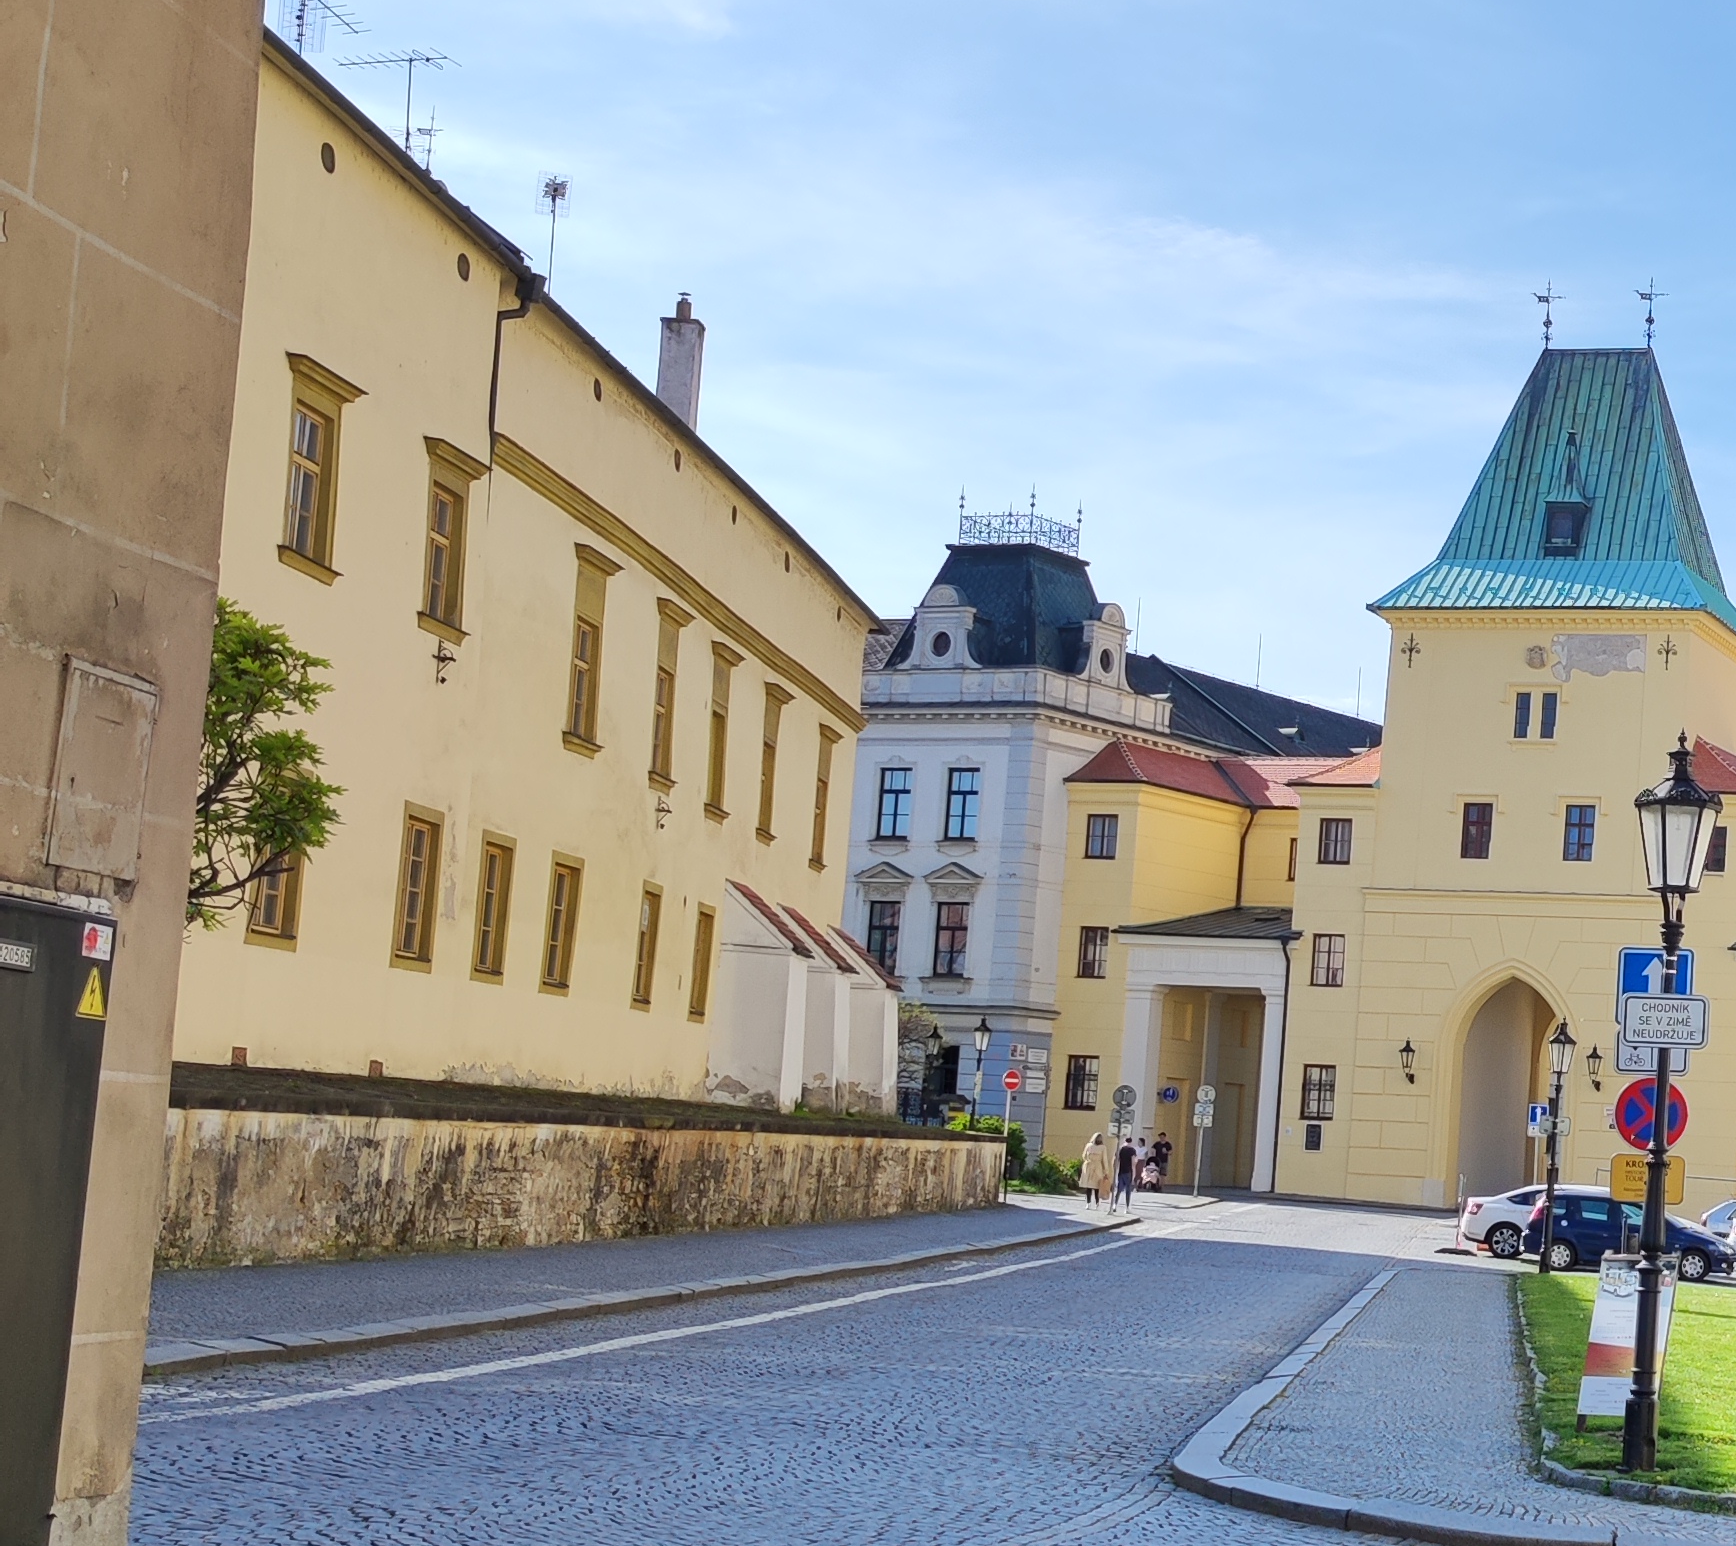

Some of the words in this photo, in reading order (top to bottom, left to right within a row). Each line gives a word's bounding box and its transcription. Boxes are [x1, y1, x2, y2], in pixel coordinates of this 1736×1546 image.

[1641, 1002, 1690, 1014] CHODNÍK
[1638, 1015, 1652, 1026] SE
[1656, 1016, 1663, 1026] V
[1666, 1015, 1692, 1027] ZIMĚ
[1632, 1028, 1697, 1041] NEUDRŽUJE
